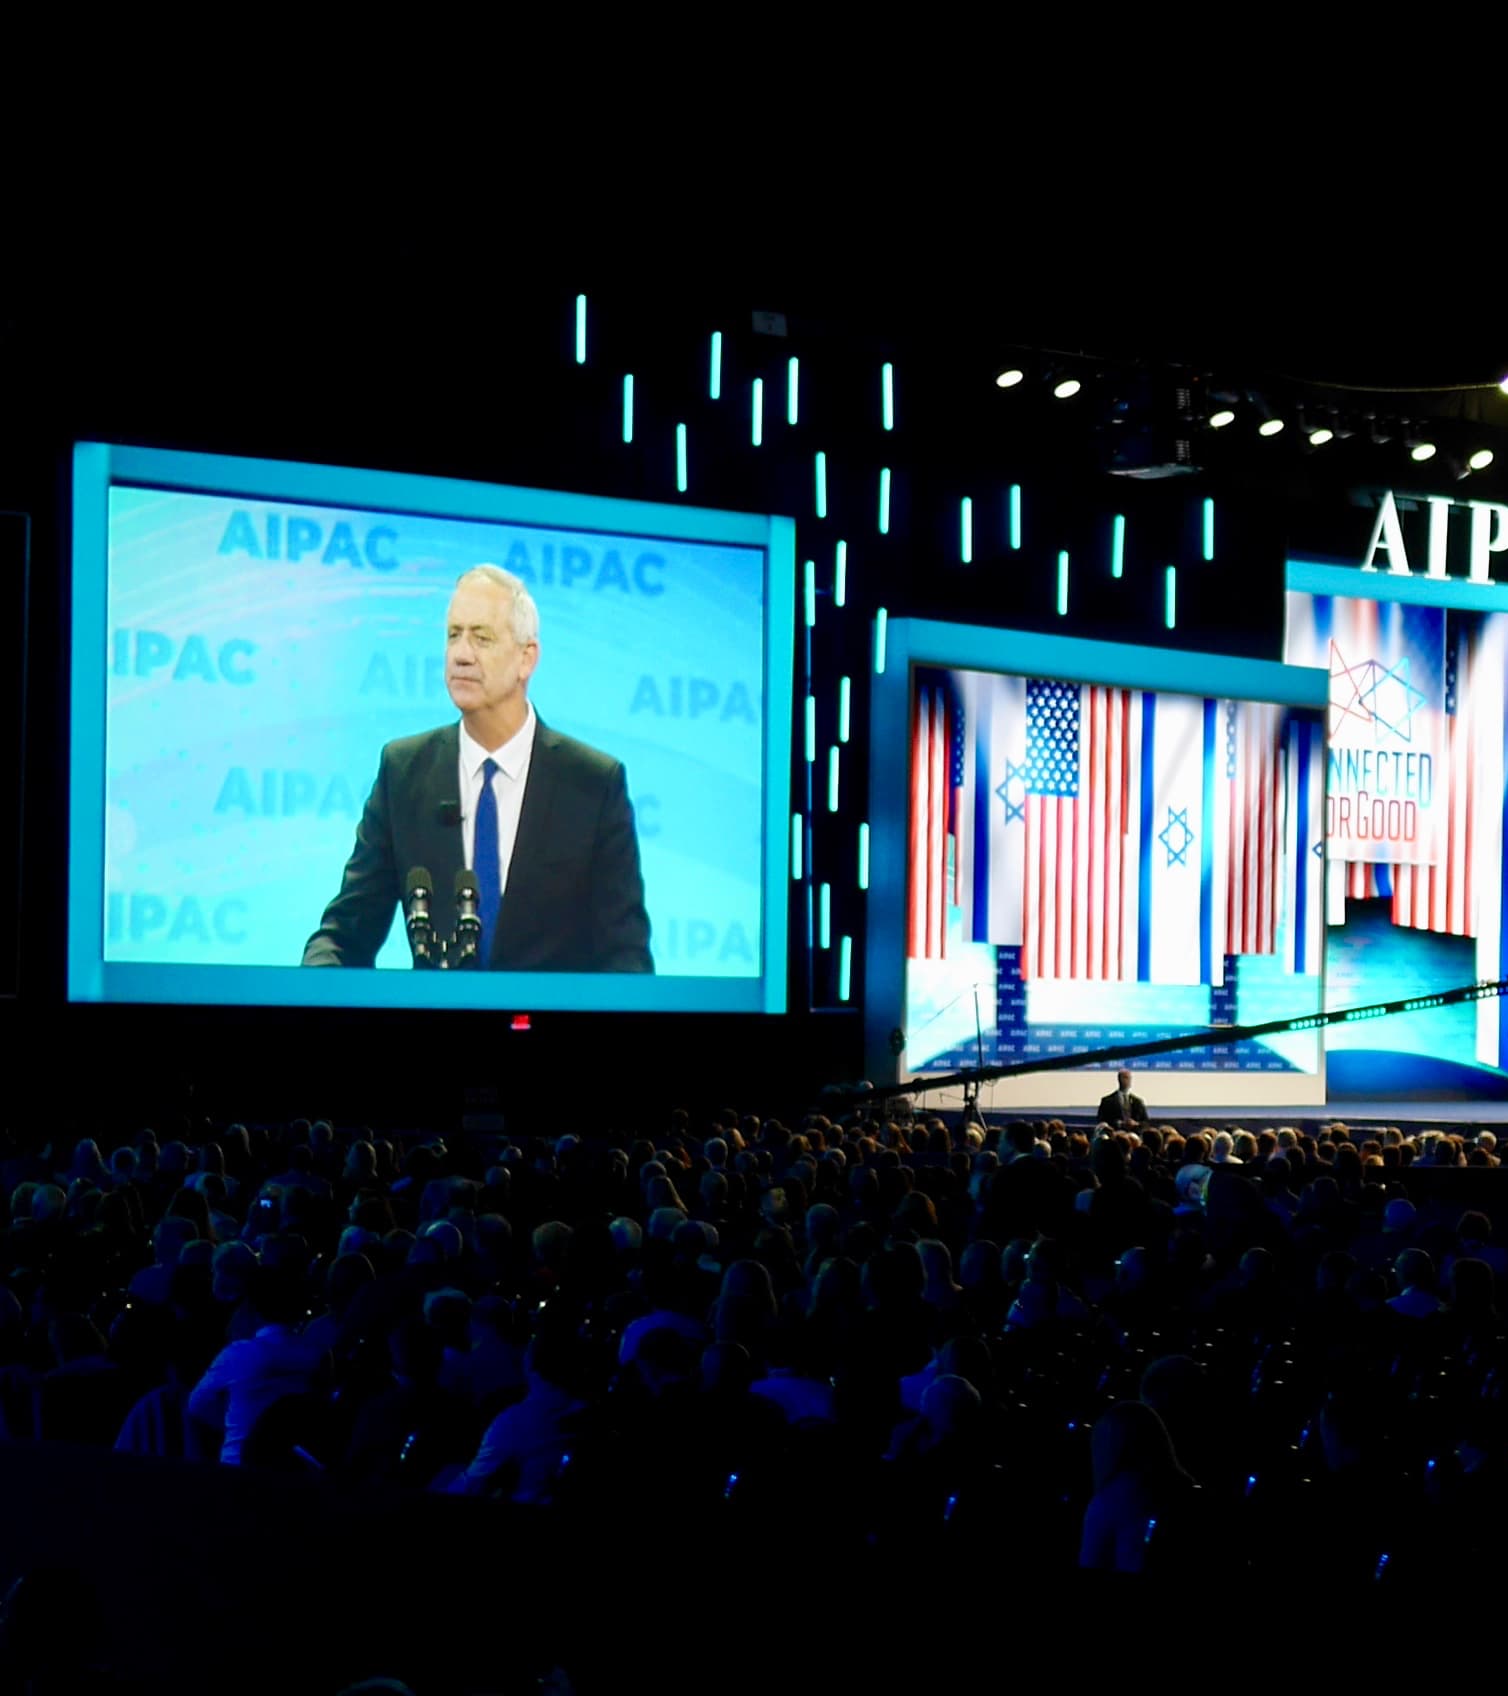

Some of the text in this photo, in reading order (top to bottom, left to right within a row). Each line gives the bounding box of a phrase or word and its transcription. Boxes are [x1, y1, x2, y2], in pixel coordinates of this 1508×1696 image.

[217, 509, 399, 572] AIPAC
[504, 540, 667, 597] AIPAC
[112, 627, 258, 686] IPAC
[629, 674, 760, 725] AIPA
[213, 767, 369, 820] AIPA
[654, 917, 752, 963] IPA
